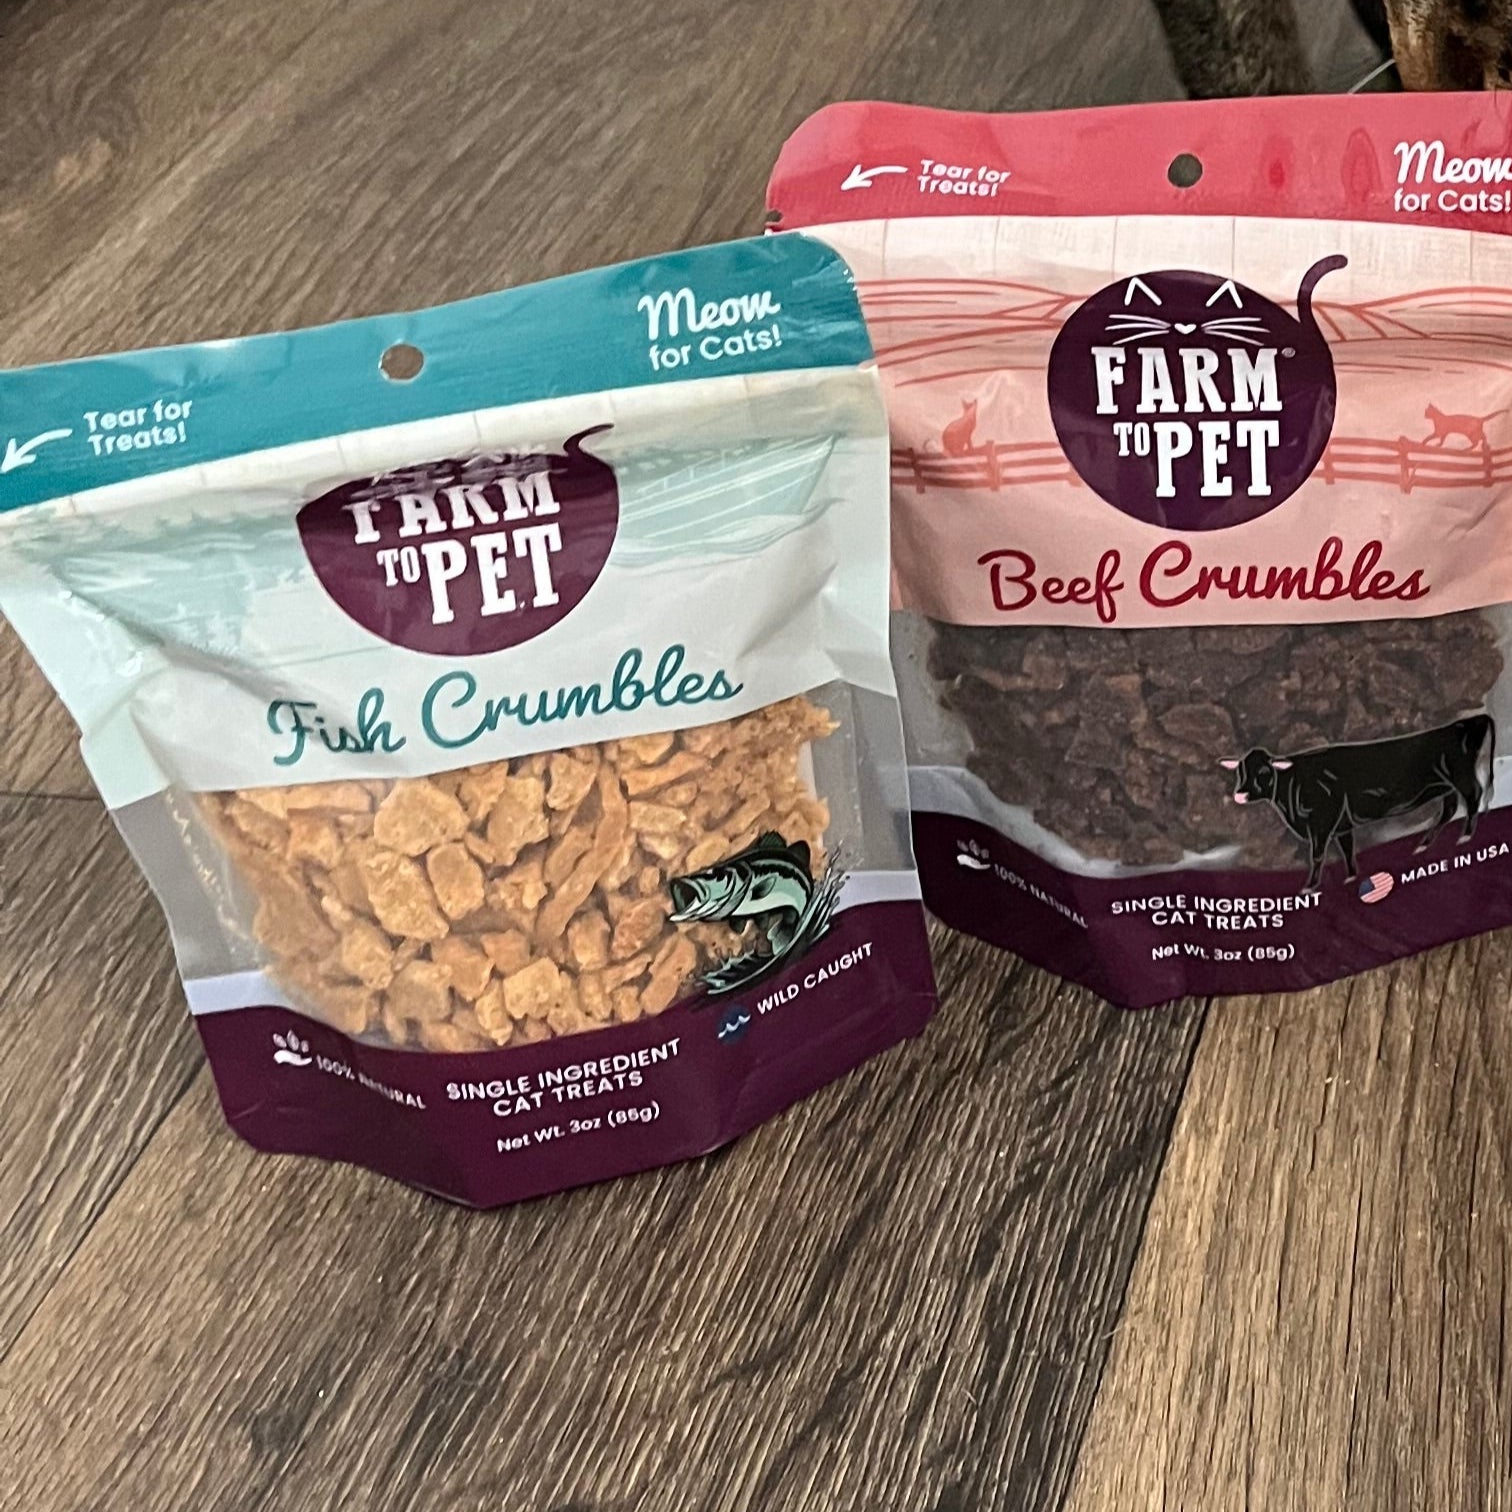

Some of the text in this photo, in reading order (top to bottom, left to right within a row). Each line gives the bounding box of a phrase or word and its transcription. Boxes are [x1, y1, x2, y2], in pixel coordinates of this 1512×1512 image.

[917, 175, 999, 197] Treats!
[920, 159, 1011, 183] Tear for
[1393, 188, 1511, 213] for Cats!
[637, 287, 781, 340] Meow
[649, 324, 782, 371] for Cats!
[1091, 346, 1283, 414] FARM
[83, 399, 193, 433] Tear for
[87, 420, 187, 456] Treats!
[1112, 419, 1280, 498] TO PET
[376, 522, 562, 625] TO PET
[977, 535, 1431, 624] Beef Crumbles
[267, 644, 744, 766] Fish Crumbles
[1400, 842, 1510, 885] MADE IN USA
[1111, 891, 1323, 915] SINGLE INGREDIENT
[1151, 911, 1284, 930] CAT TREATS
[1151, 943, 1180, 961] Net
[1213, 948, 1242, 961] 3oz
[757, 941, 873, 1015] WILD CAUGHT
[446, 1037, 681, 1101] SINGLE INGREDIENT
[493, 1070, 644, 1117] CAT TREATS
[496, 1134, 531, 1153] Net
[569, 1117, 602, 1134] 3oz
